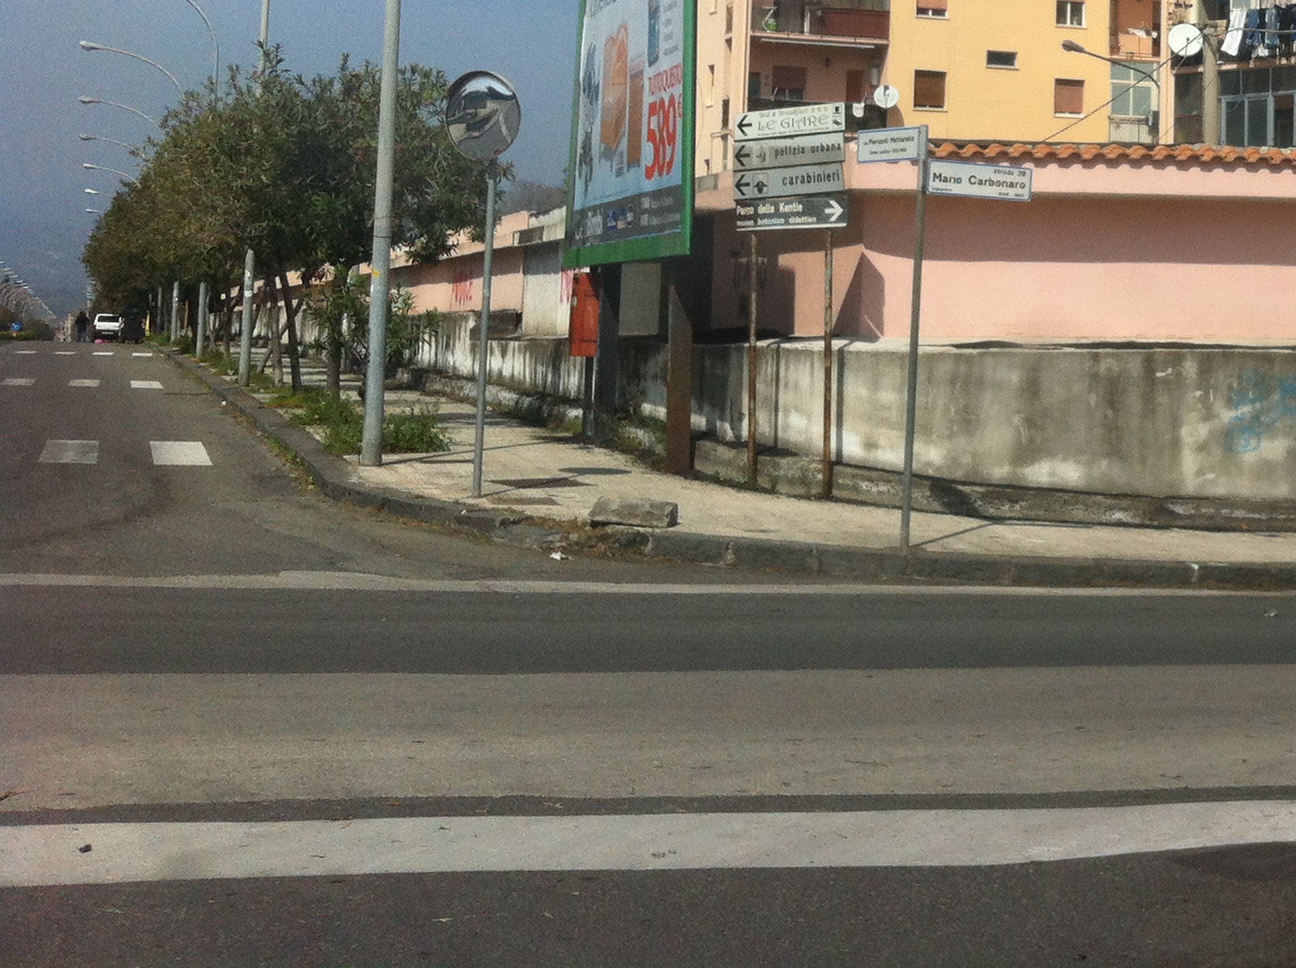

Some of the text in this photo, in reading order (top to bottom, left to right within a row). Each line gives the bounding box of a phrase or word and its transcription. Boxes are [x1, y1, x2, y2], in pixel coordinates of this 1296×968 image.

[775, 142, 841, 159] polizia urbana
[782, 169, 840, 186] carabinieri
[932, 172, 962, 185] Mario
[968, 174, 1026, 190] Carbonaro
